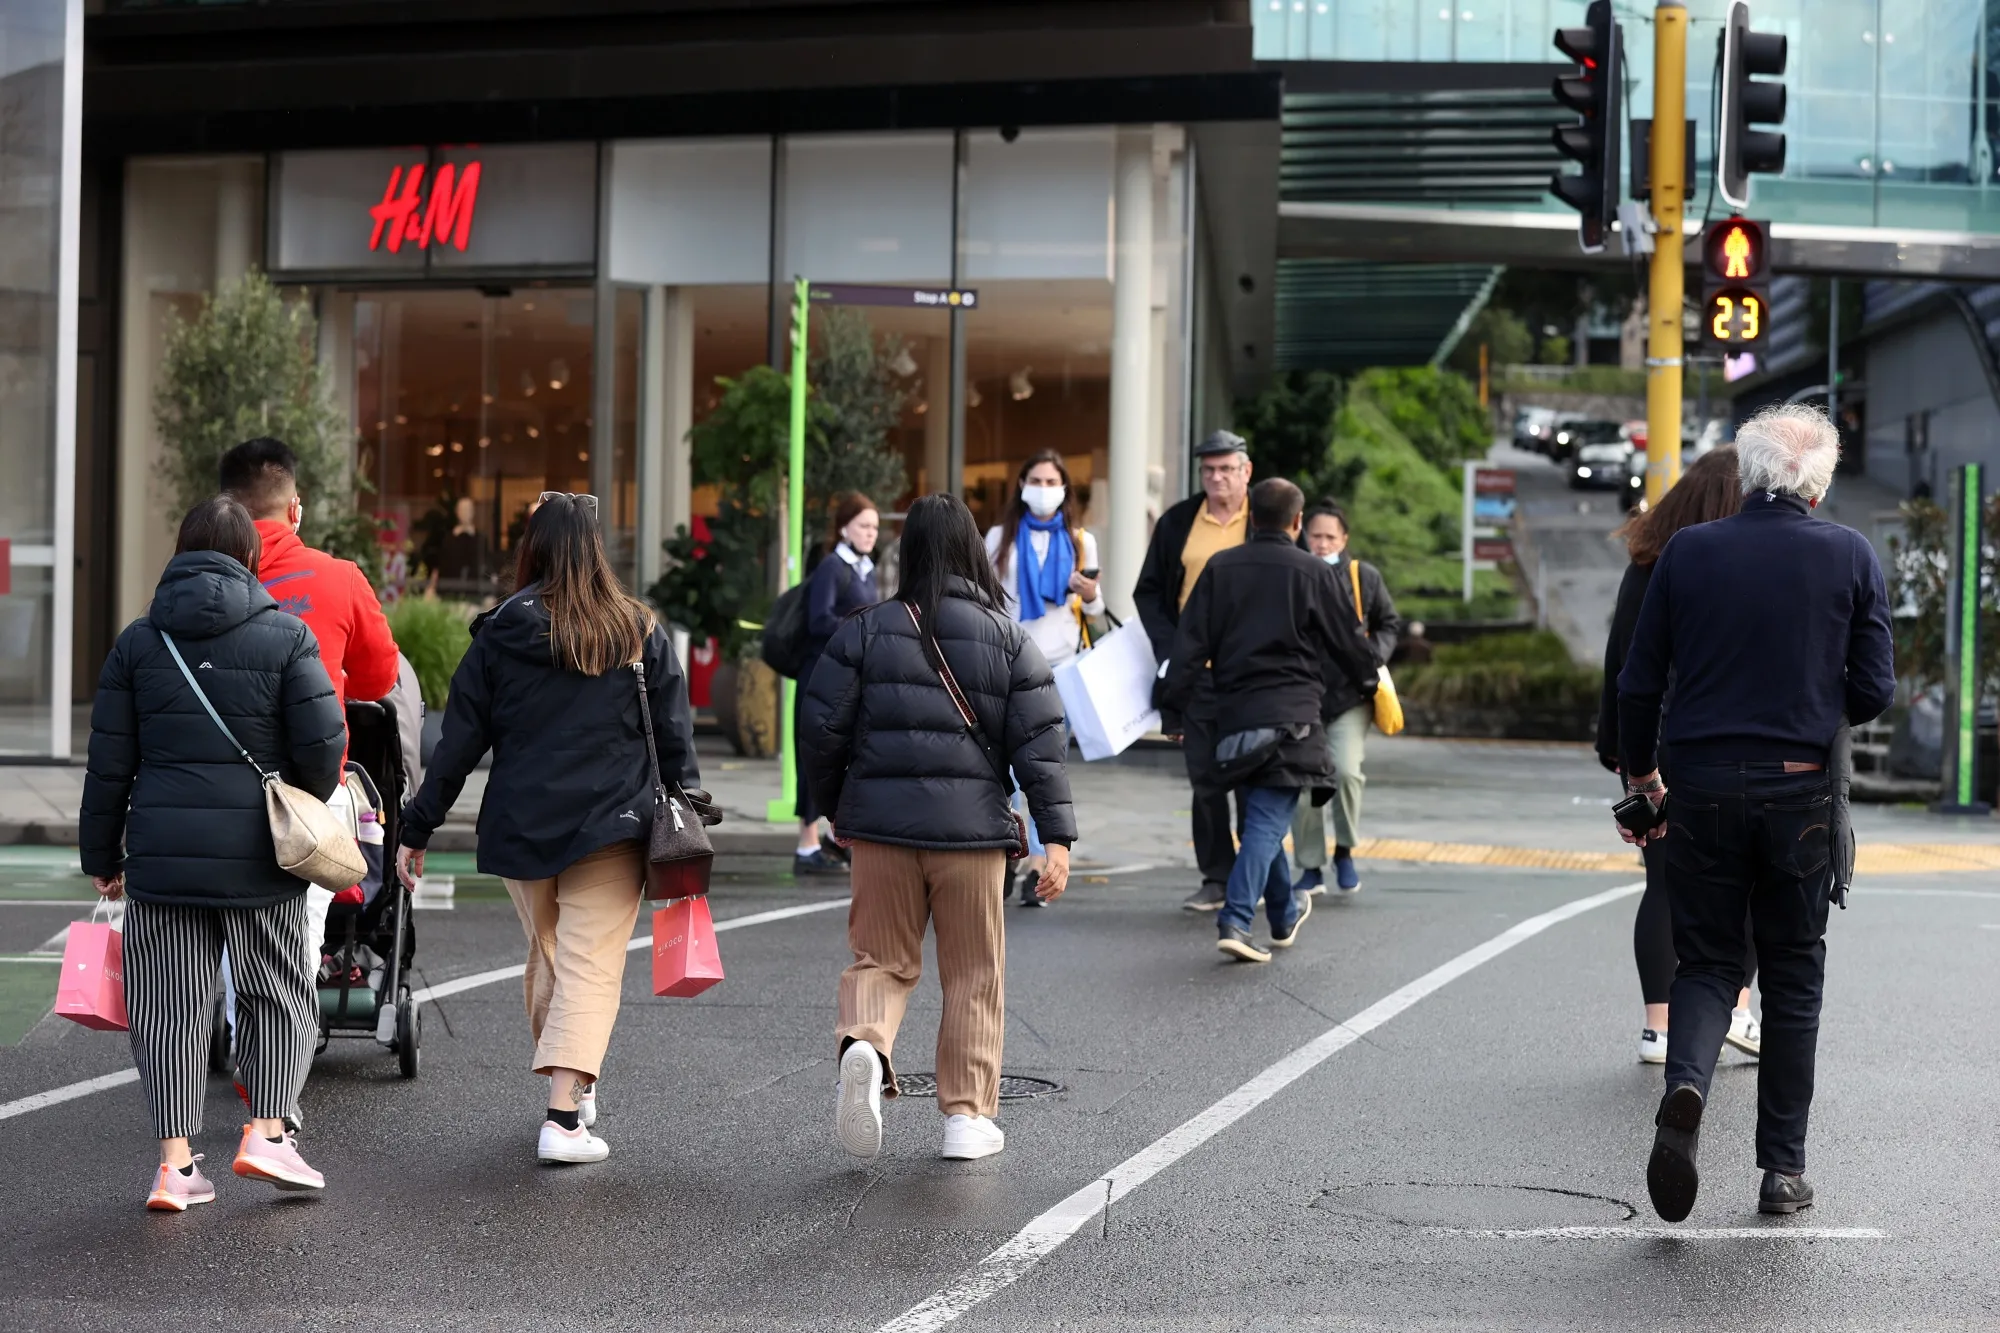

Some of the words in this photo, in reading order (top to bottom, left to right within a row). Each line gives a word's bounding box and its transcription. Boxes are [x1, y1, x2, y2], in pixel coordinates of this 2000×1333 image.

[368, 161, 481, 254] H&M
[913, 290, 938, 305] Stop
[939, 292, 948, 304] A
[1713, 297, 1759, 339] 23
[657, 935, 683, 955] HIKOCO
[104, 966, 123, 983] HIKOC
